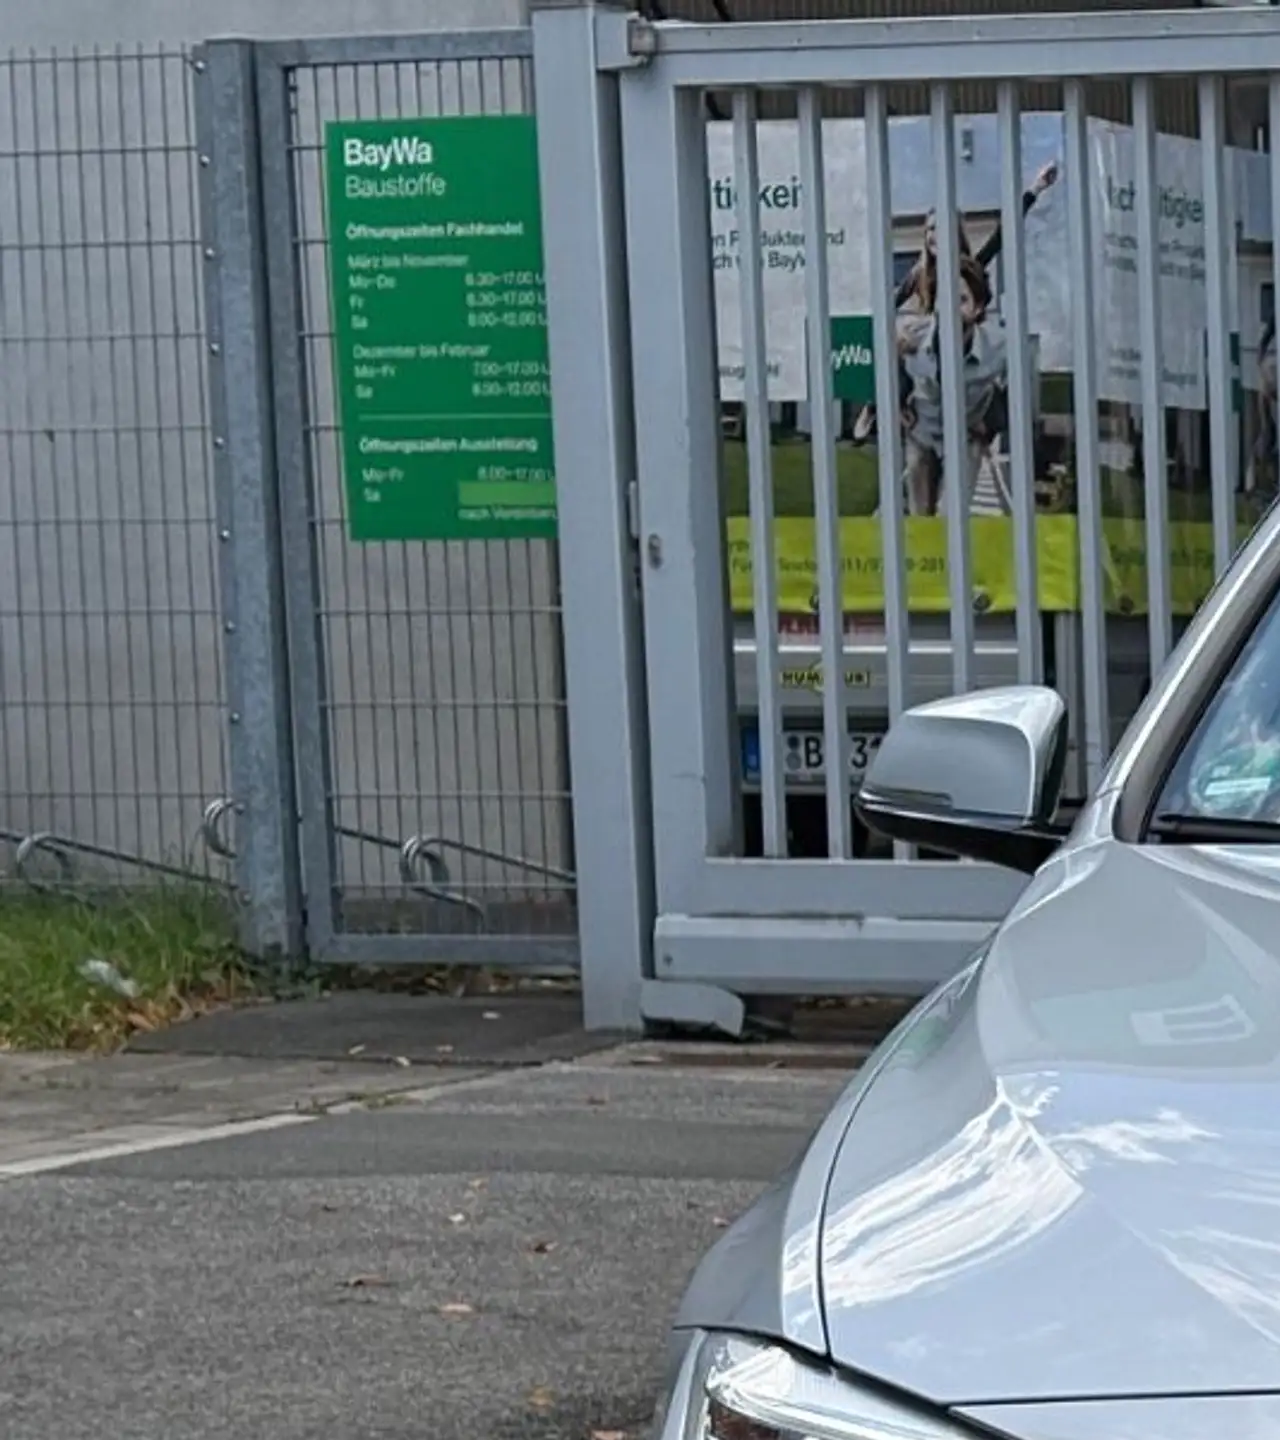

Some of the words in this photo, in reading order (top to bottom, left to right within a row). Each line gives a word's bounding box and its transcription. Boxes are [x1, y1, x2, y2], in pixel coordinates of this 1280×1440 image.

[343, 137, 433, 171] BayWa
[345, 172, 446, 198] Baustoffe
[830, 343, 872, 370] yWa
